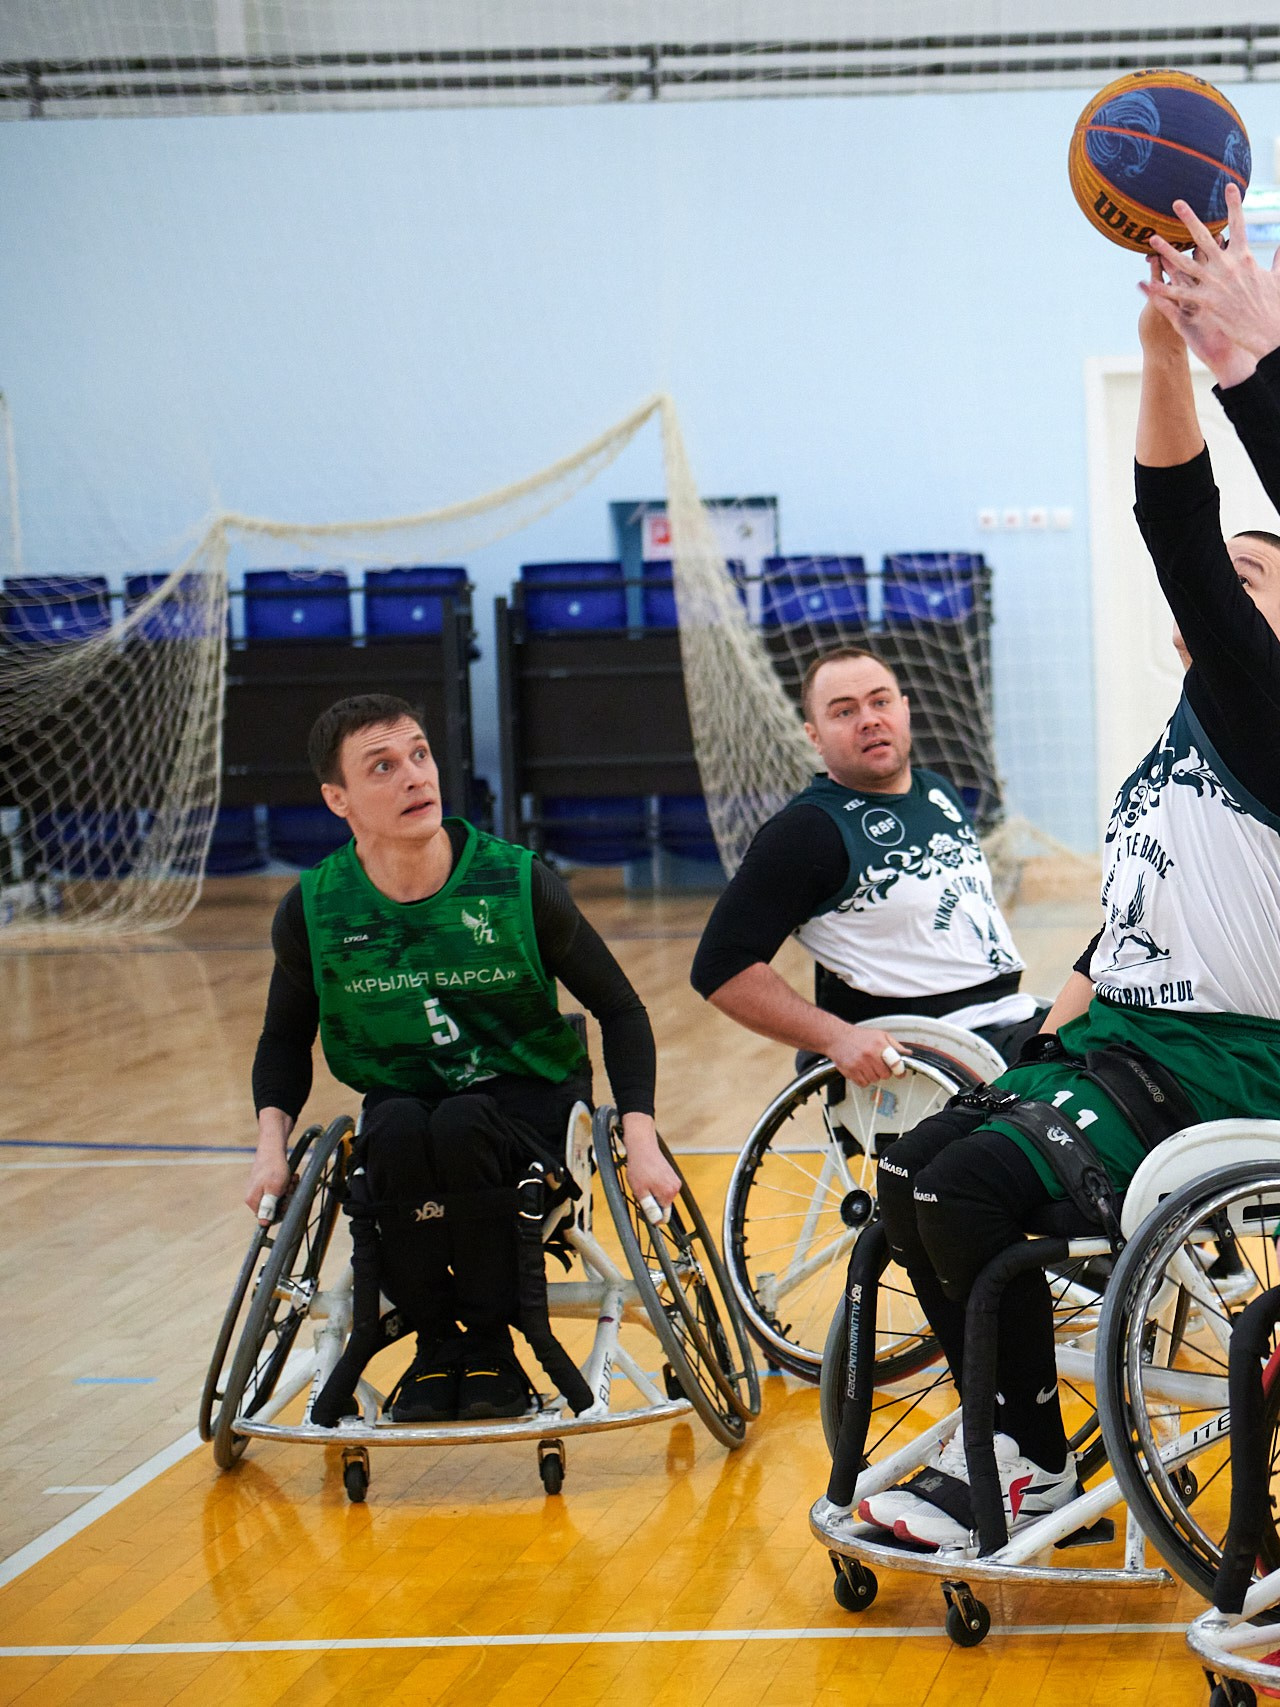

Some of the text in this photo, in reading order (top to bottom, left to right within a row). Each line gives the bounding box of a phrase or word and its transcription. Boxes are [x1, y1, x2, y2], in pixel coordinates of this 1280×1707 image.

[928, 788, 962, 823] 9
[868, 817, 896, 838] RBF
[933, 888, 960, 931] WINGS
[435, 967, 516, 987] БАРСА»
[1160, 979, 1194, 1004] CLUB
[423, 998, 460, 1046] 5
[1051, 1090, 1099, 1130] 11
